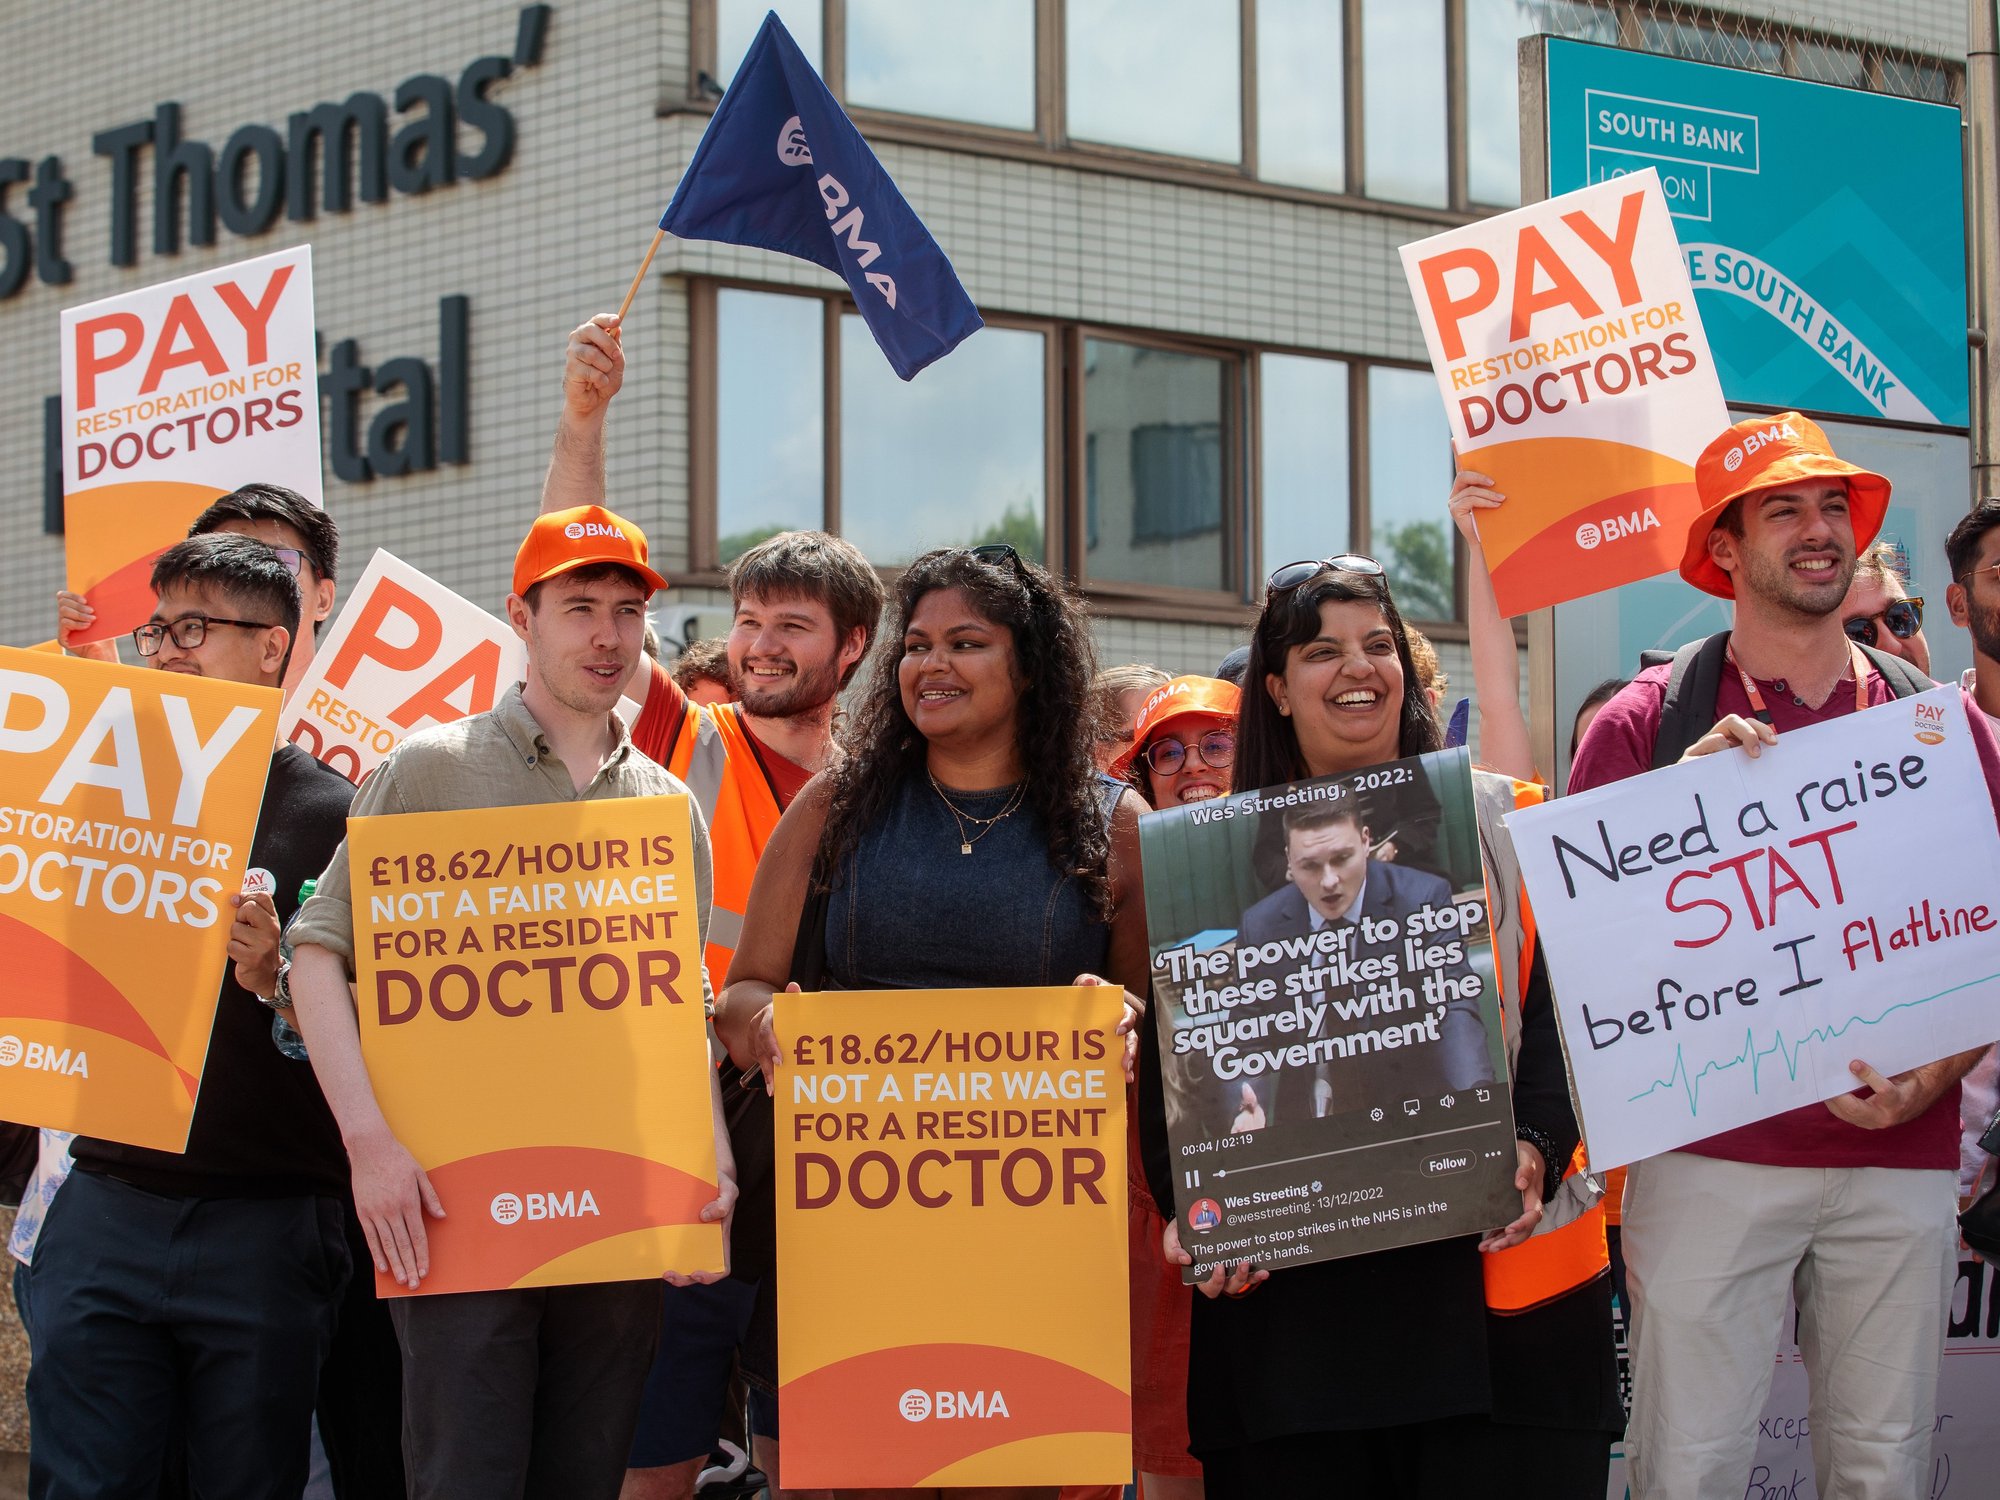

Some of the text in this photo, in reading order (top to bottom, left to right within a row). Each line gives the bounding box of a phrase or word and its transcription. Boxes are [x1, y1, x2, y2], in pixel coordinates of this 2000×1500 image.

[93, 3, 550, 268] Thomas'
[1599, 110, 1745, 155] SOUTH BANK
[818, 173, 897, 310] BMA
[1418, 190, 1645, 362] PAY
[75, 264, 296, 411] PAY
[1451, 301, 1685, 391] RESTORATION FOR
[1714, 253, 1815, 334] SOUTH
[1817, 320, 1896, 408] BANK
[76, 362, 302, 437] RESTORATION FOR
[1459, 333, 1697, 438] DOCTORS
[77, 389, 303, 480] DOCTORS
[1743, 423, 1801, 455] BMA
[586, 523, 626, 541] BMA
[1601, 507, 1661, 541] BMA
[323, 575, 502, 730] PA
[1148, 682, 1191, 712] BMA
[1916, 703, 1945, 721] PAY
[0, 668, 262, 828] PAY
[1914, 721, 1944, 732] DOCTORS
[1190, 767, 1415, 827] Wes Streeting, 2022:
[1552, 755, 1928, 899] Need a raise
[170, 836, 233, 871] FOR
[244, 872, 265, 887] AY
[369, 835, 675, 887] £18.62/HOUR IS
[371, 874, 678, 924] NOT A FAIR WAGE
[1666, 821, 1857, 948] STAT
[373, 911, 679, 960] FOR A RESIDENT
[1235, 925, 1353, 975] power
[1360, 914, 1400, 945] to
[1406, 900, 1484, 938] stop
[375, 949, 685, 1026] DOCTOR
[1183, 939, 1465, 1017] these strikes lies
[1583, 900, 1998, 1050] before I flatline
[1173, 967, 1483, 1060] squarely with the
[24, 1041, 89, 1079] BMA
[793, 1029, 1106, 1066] £18.62/HOUR IS
[1212, 1007, 1448, 1080] Government'
[793, 1069, 1107, 1104] NOT A FAIR WAGE
[793, 1108, 1107, 1142] FOR A RESIDENT
[1182, 1141, 1213, 1156] 00:04
[1221, 1134, 1253, 1148] 02:19
[794, 1147, 1108, 1211] DOCTOR
[1429, 1157, 1467, 1172] Follow
[526, 1189, 600, 1221] BMA
[1224, 1184, 1309, 1209] Wes Streeting
[1226, 1186, 1384, 1226] @wesstreeting 13/12/2022
[1192, 1200, 1448, 1256] The power to stop strikes in the NHS is in the
[1273, 1243, 1313, 1259] hands.
[935, 1390, 1010, 1419] BMA
